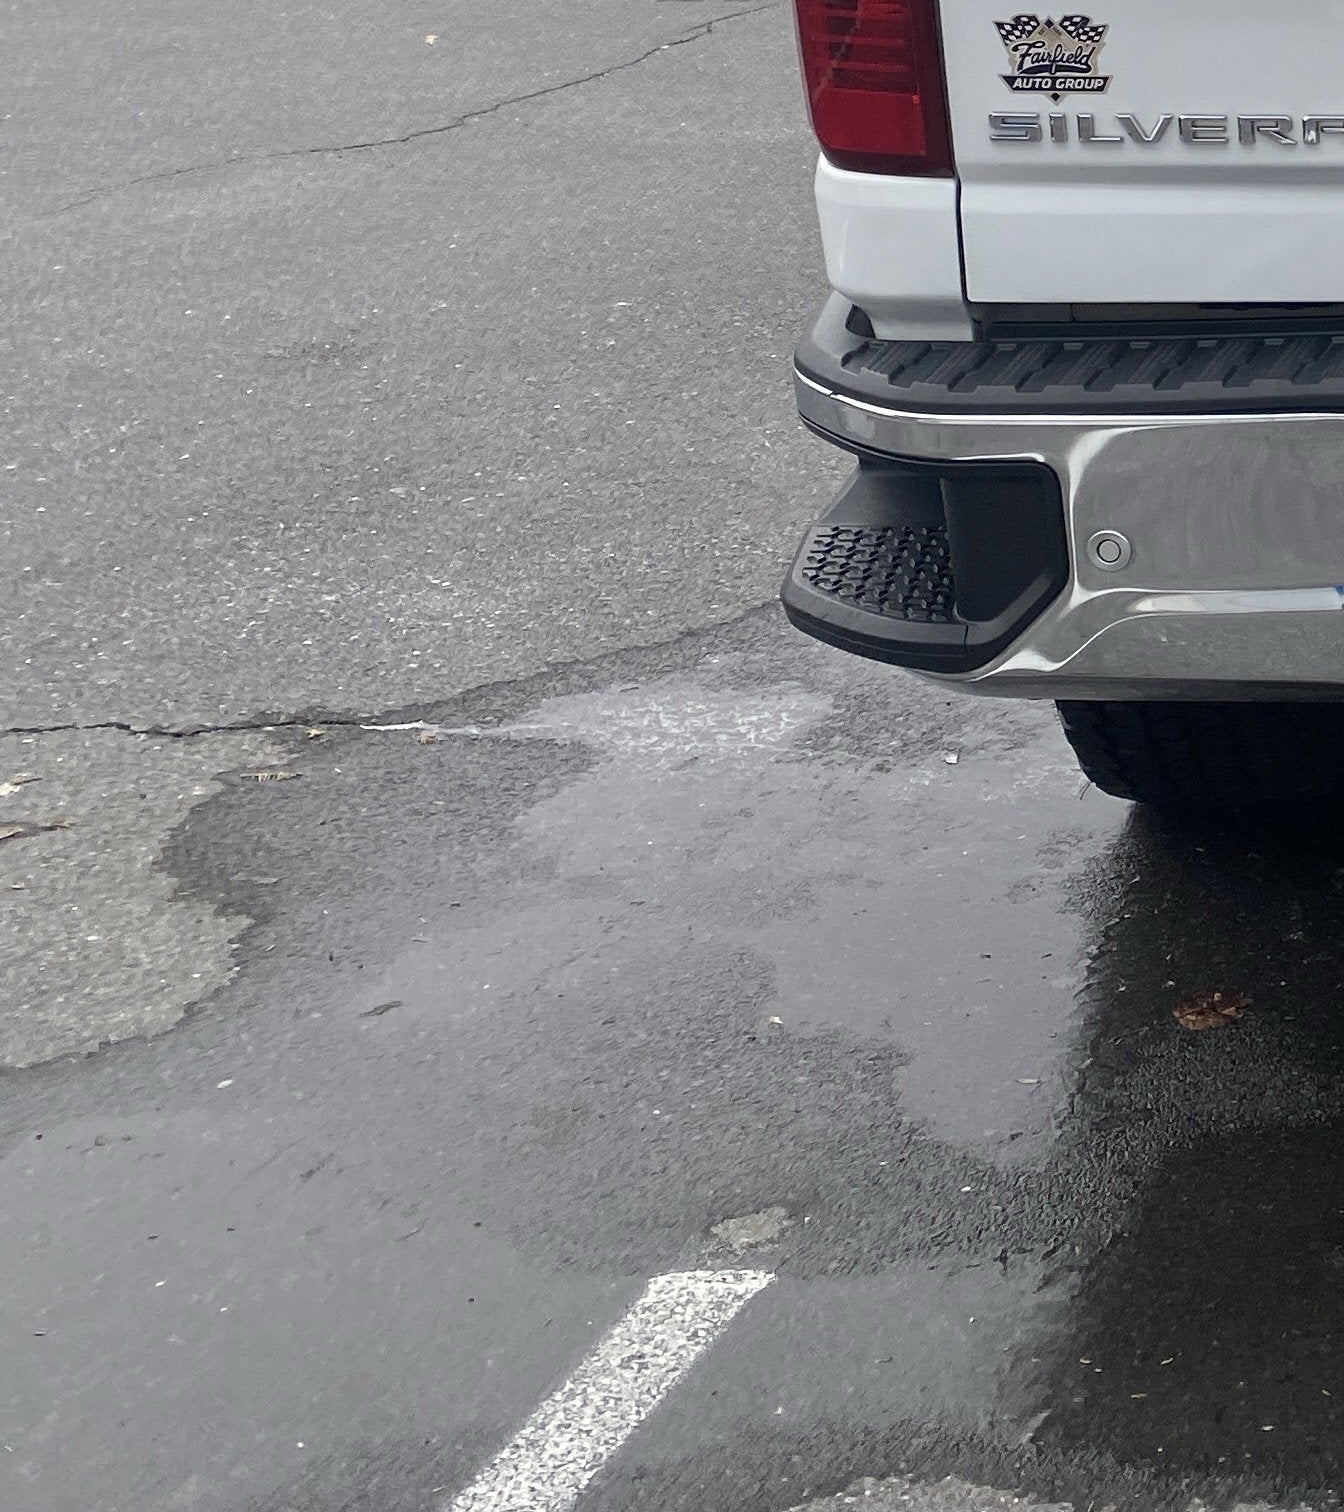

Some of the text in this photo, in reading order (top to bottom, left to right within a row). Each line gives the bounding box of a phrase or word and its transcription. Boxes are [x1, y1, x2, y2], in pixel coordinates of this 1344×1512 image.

[1011, 40, 1097, 74] Fairfield
[1012, 77, 1105, 90] AUTO GROUP
